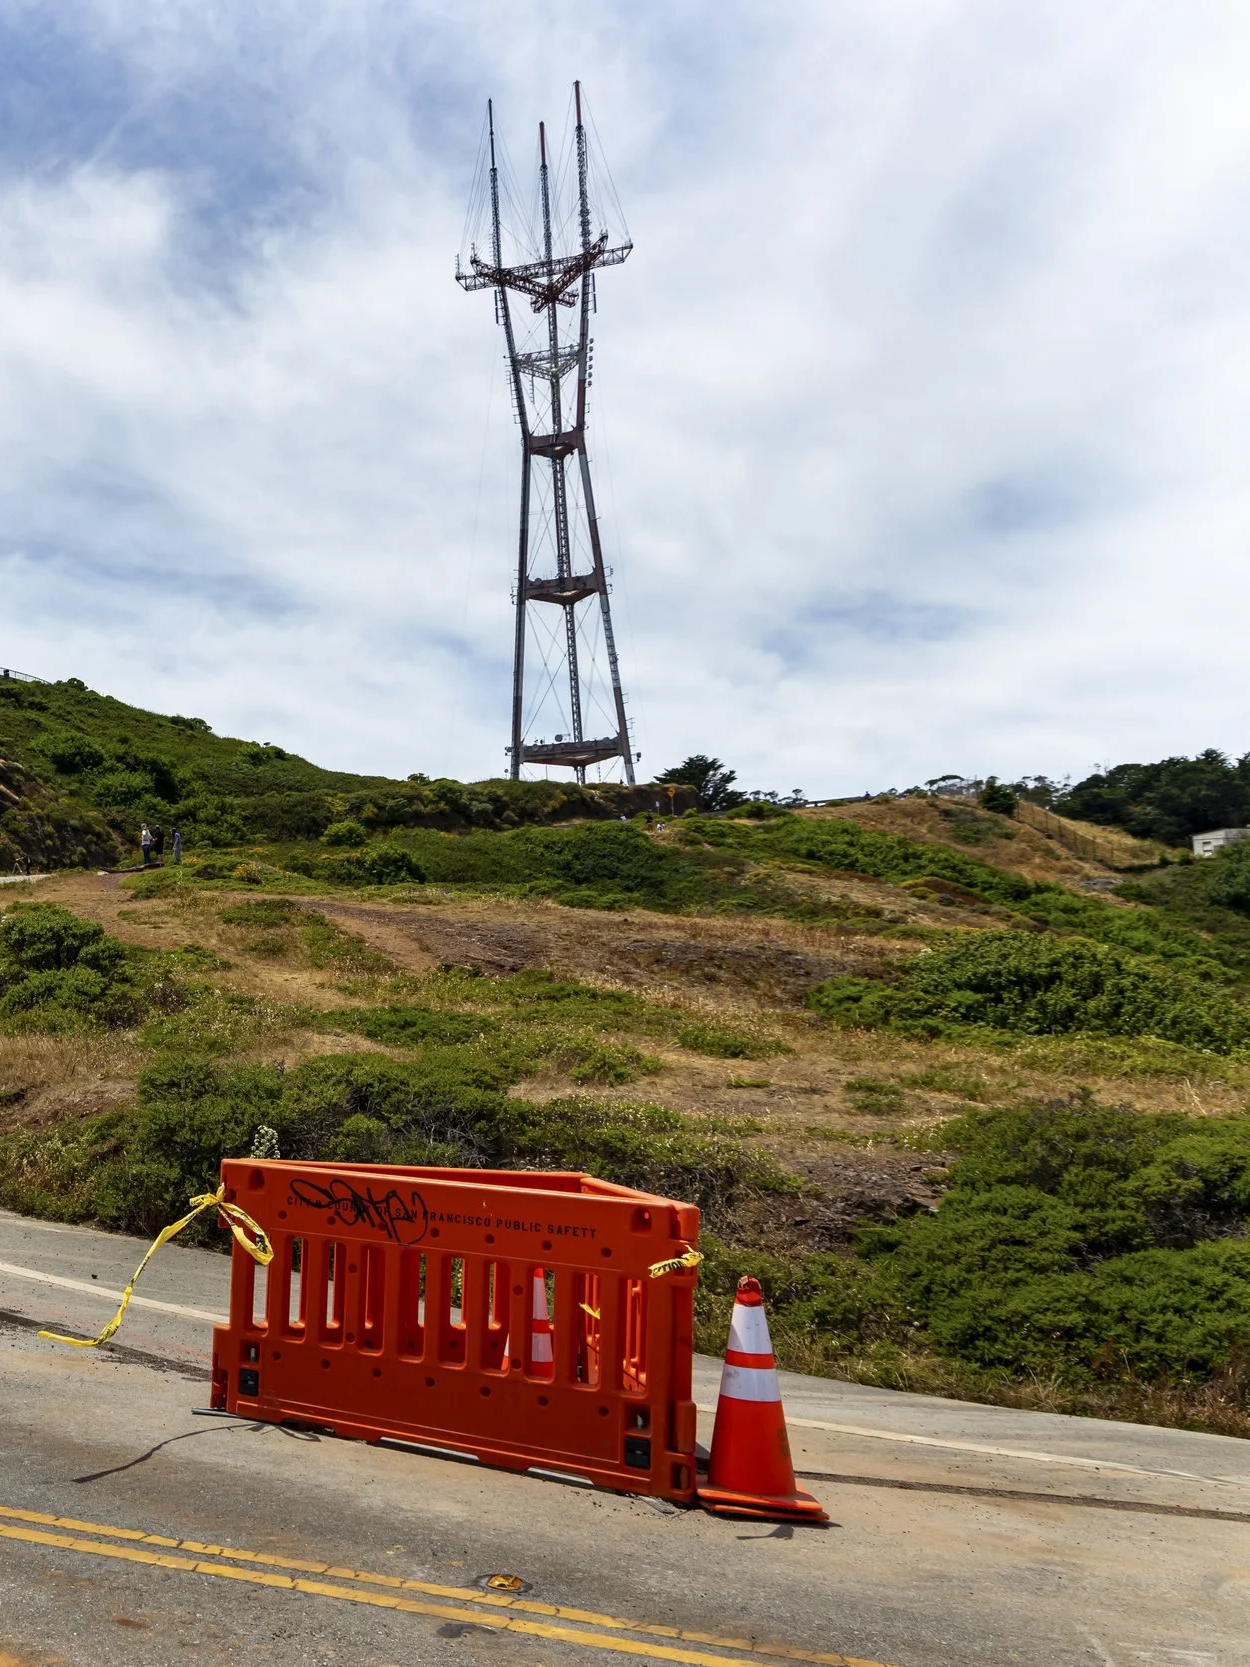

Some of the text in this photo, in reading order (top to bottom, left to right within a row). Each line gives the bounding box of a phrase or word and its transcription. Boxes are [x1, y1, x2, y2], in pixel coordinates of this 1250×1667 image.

[423, 1211, 491, 1227] FRANCISCO
[496, 1218, 541, 1232] PUBLIC
[547, 1224, 597, 1239] SAFETY
